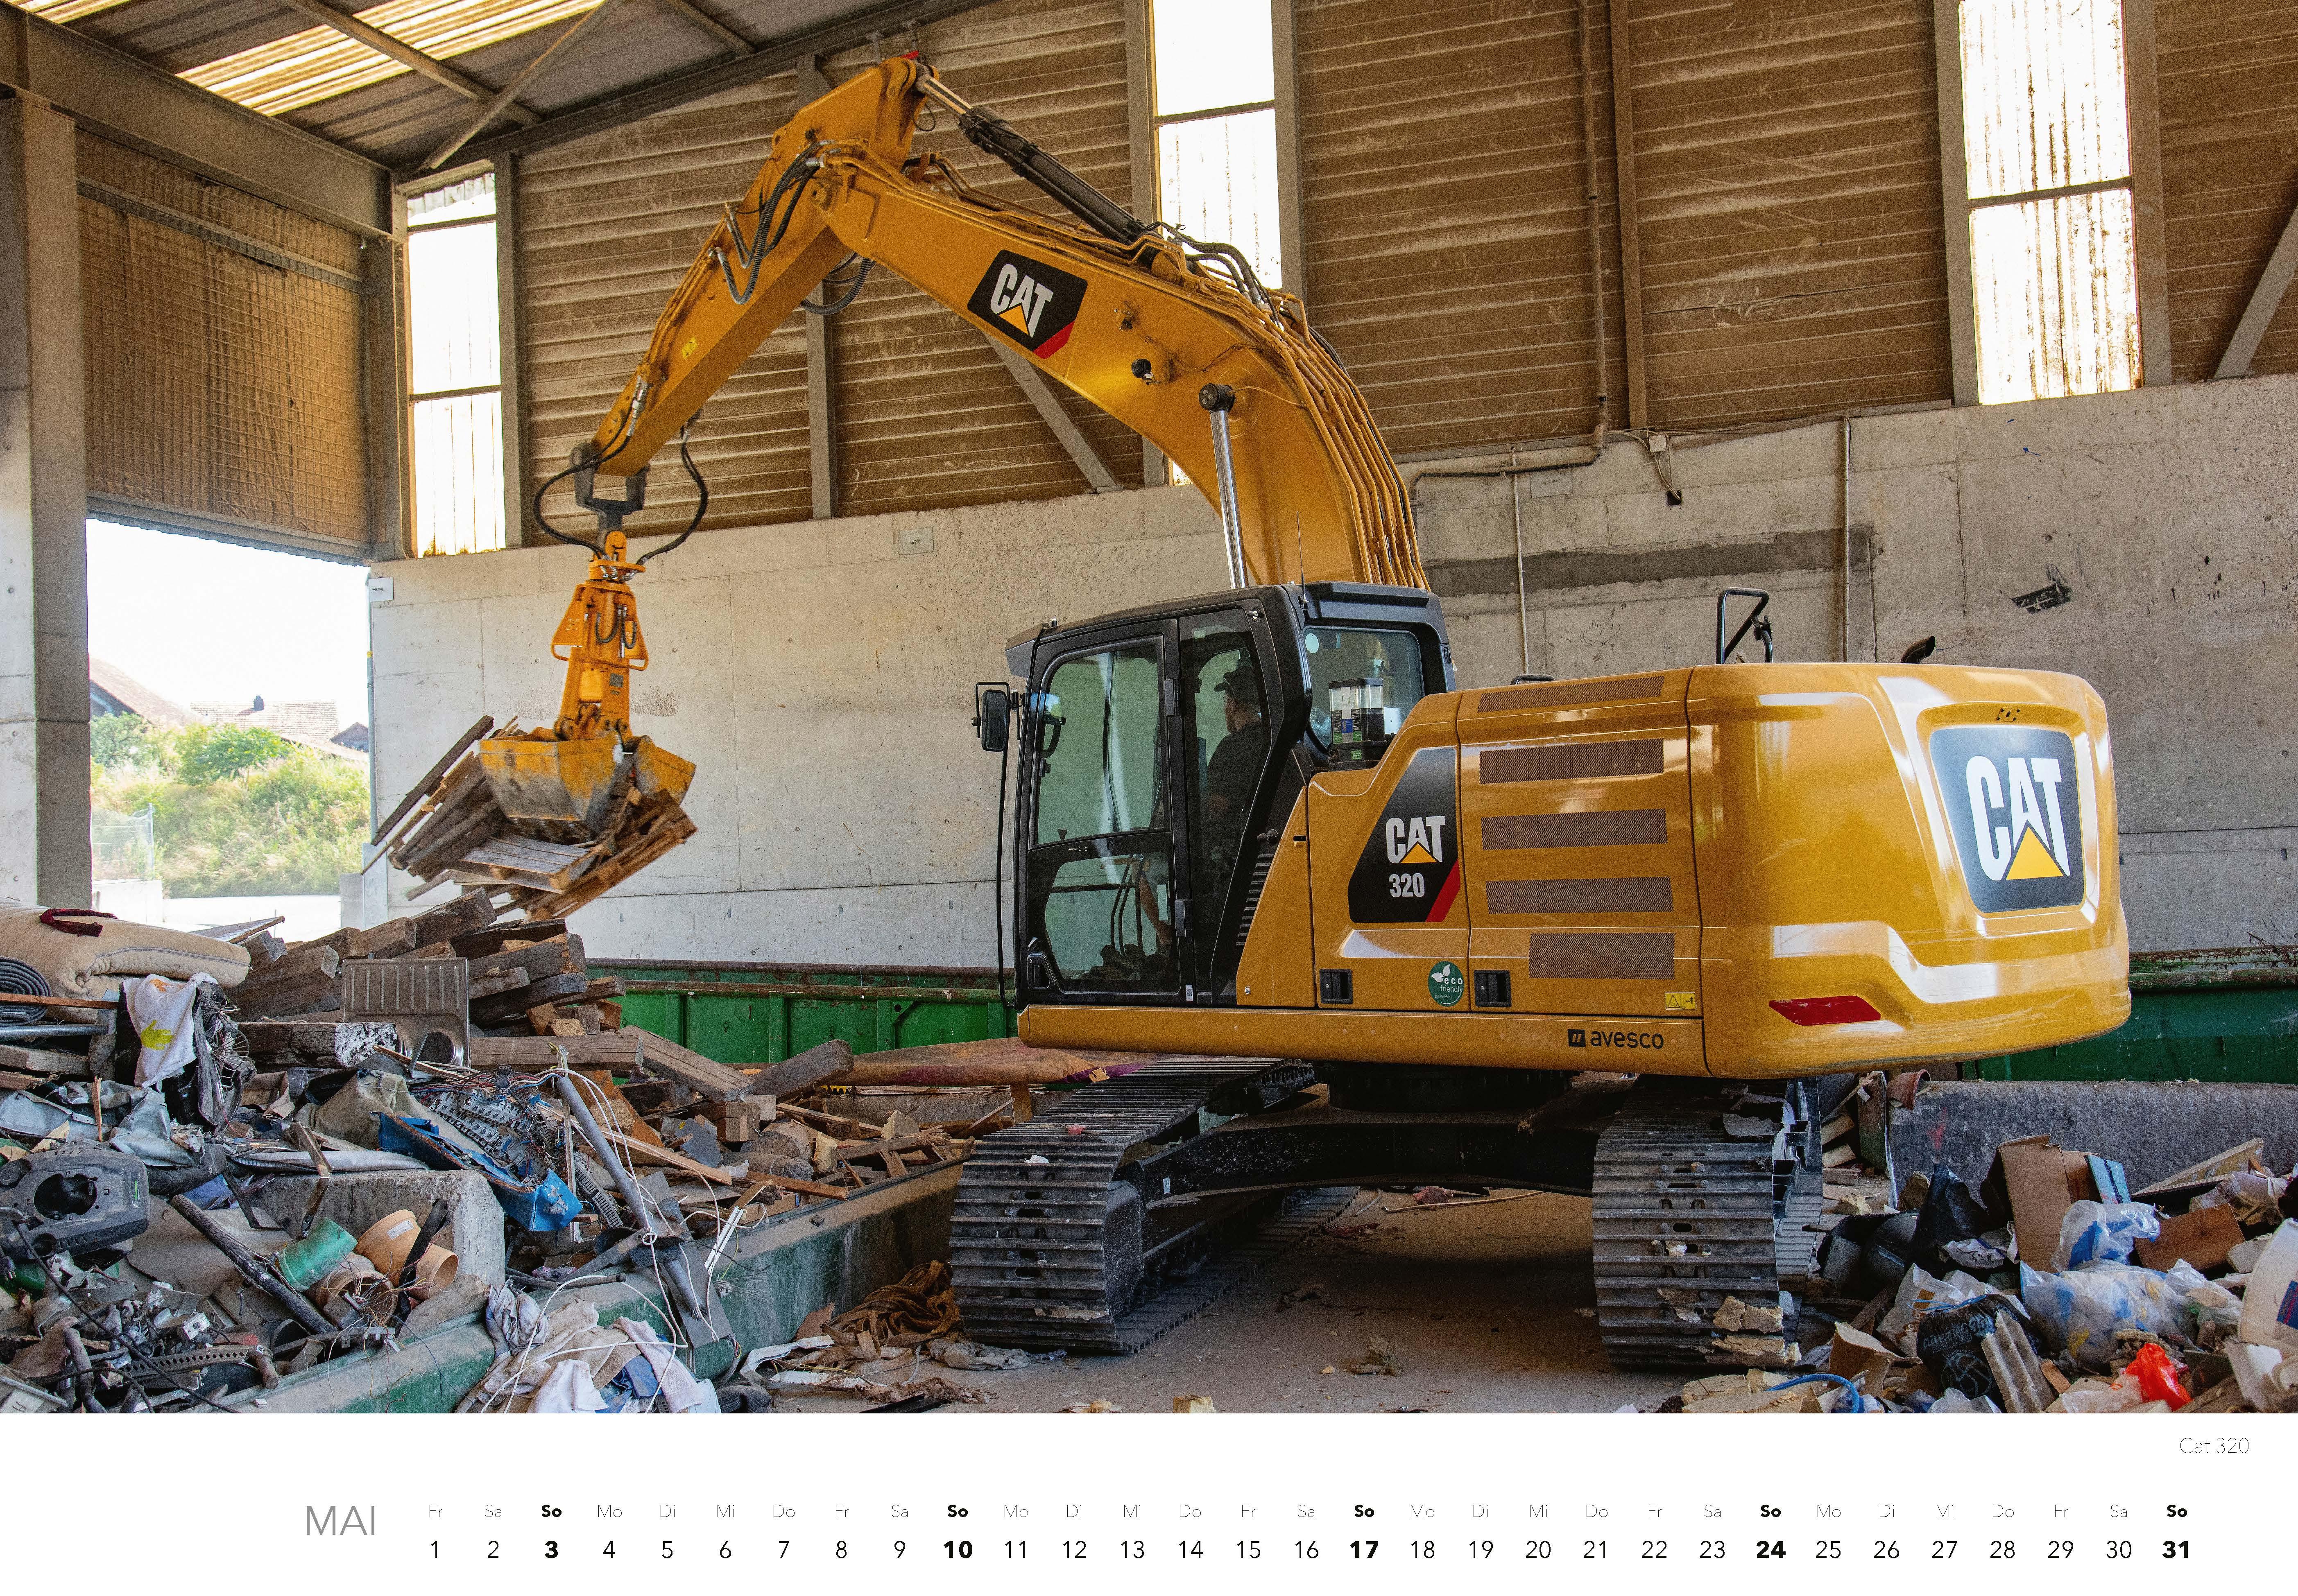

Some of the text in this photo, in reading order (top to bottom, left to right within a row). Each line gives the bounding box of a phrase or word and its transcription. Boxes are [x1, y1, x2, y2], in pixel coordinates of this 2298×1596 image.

[990, 263, 1053, 338] CAT
[1386, 816, 1445, 864] CAT
[1966, 755, 2069, 881] CAT
[1389, 873, 1425, 897] 320
[1591, 1031, 1664, 1049] avesco
